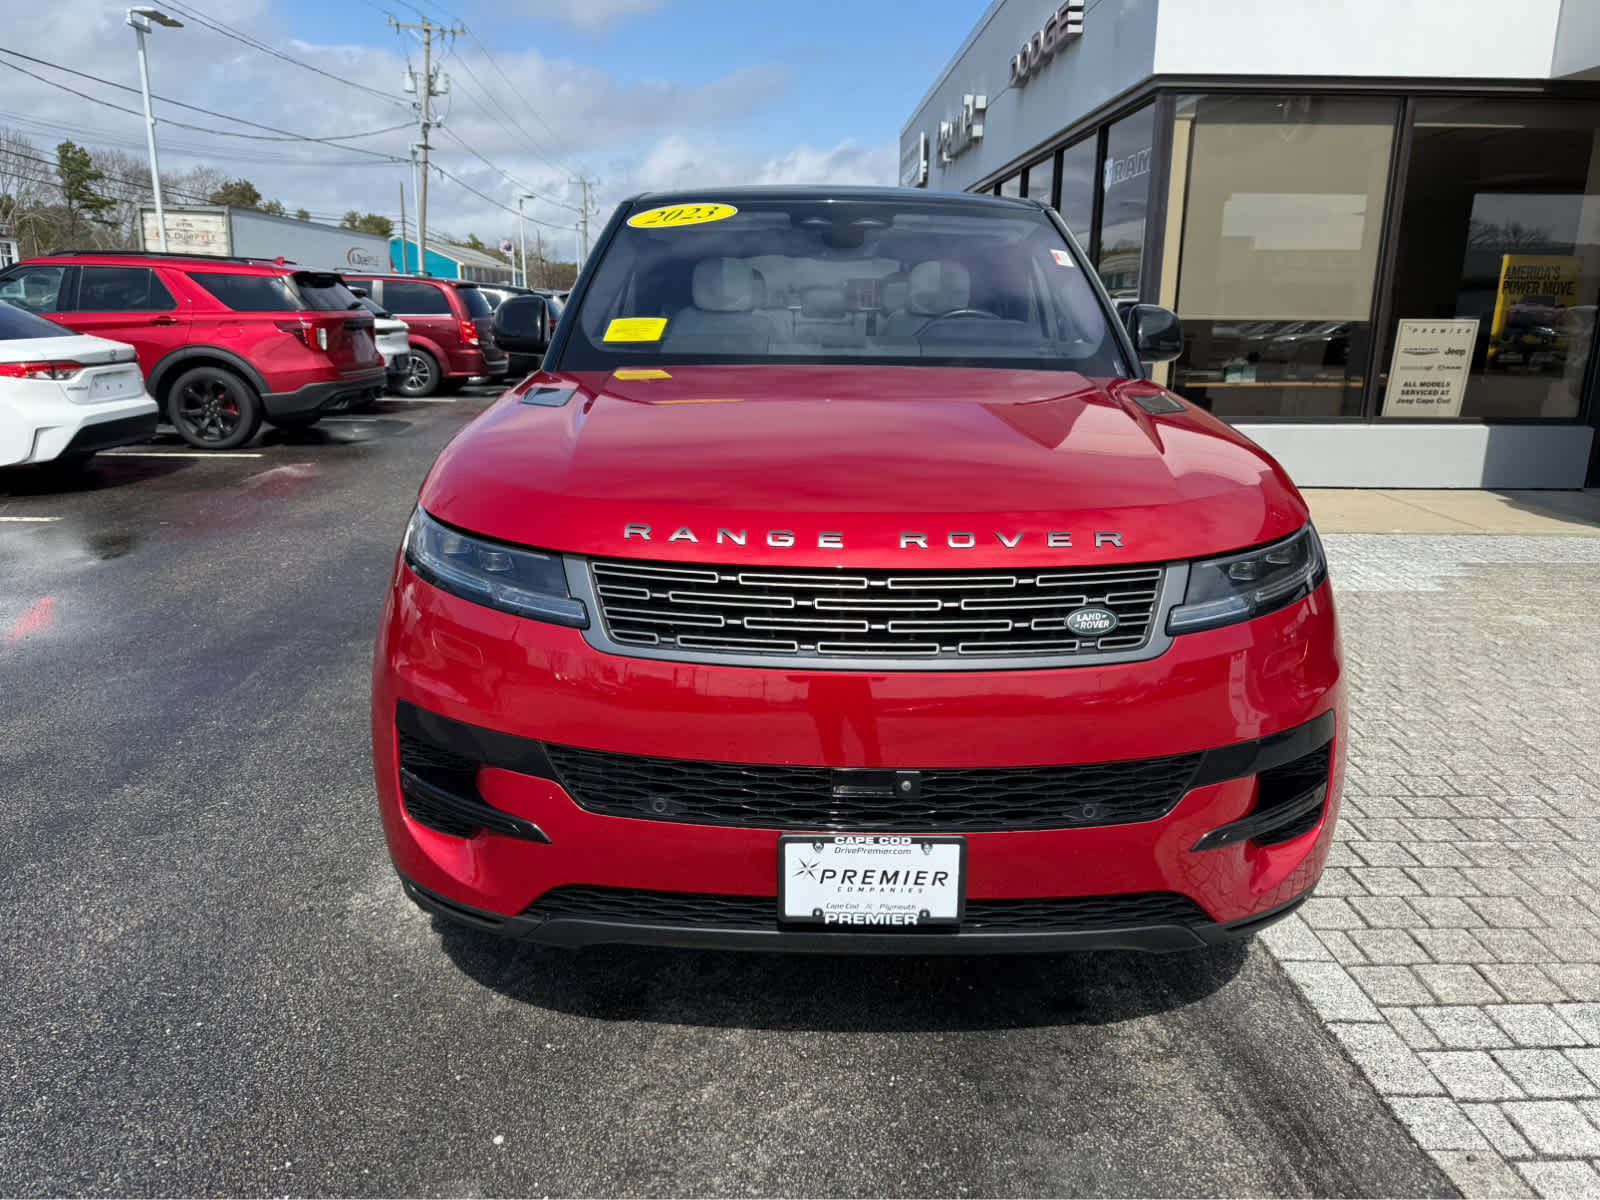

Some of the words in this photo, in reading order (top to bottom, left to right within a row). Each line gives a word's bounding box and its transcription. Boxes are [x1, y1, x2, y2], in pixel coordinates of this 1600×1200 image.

[1008, 0, 1085, 89] DODGE
[642, 206, 720, 225] 2023
[1504, 265, 1561, 281] AMERICA'S
[1502, 280, 1540, 296] POWER
[1542, 280, 1575, 295] MOVE
[1411, 327, 1472, 335] PREMIER
[1444, 346, 1466, 357] Jeep
[1402, 381, 1417, 389] ALL
[623, 522, 845, 549] RANGE
[899, 531, 1125, 549] ROVER
[1076, 612, 1101, 623] LAND
[1080, 619, 1110, 630] ROVER
[834, 836, 875, 846] CAPE
[878, 836, 913, 847] COD
[834, 847, 912, 855] DrivePremier.com
[819, 868, 950, 888] PREMIER
[825, 902, 845, 911] Cape
[880, 903, 917, 912] Plymouth
[824, 912, 919, 926] PREMIER
